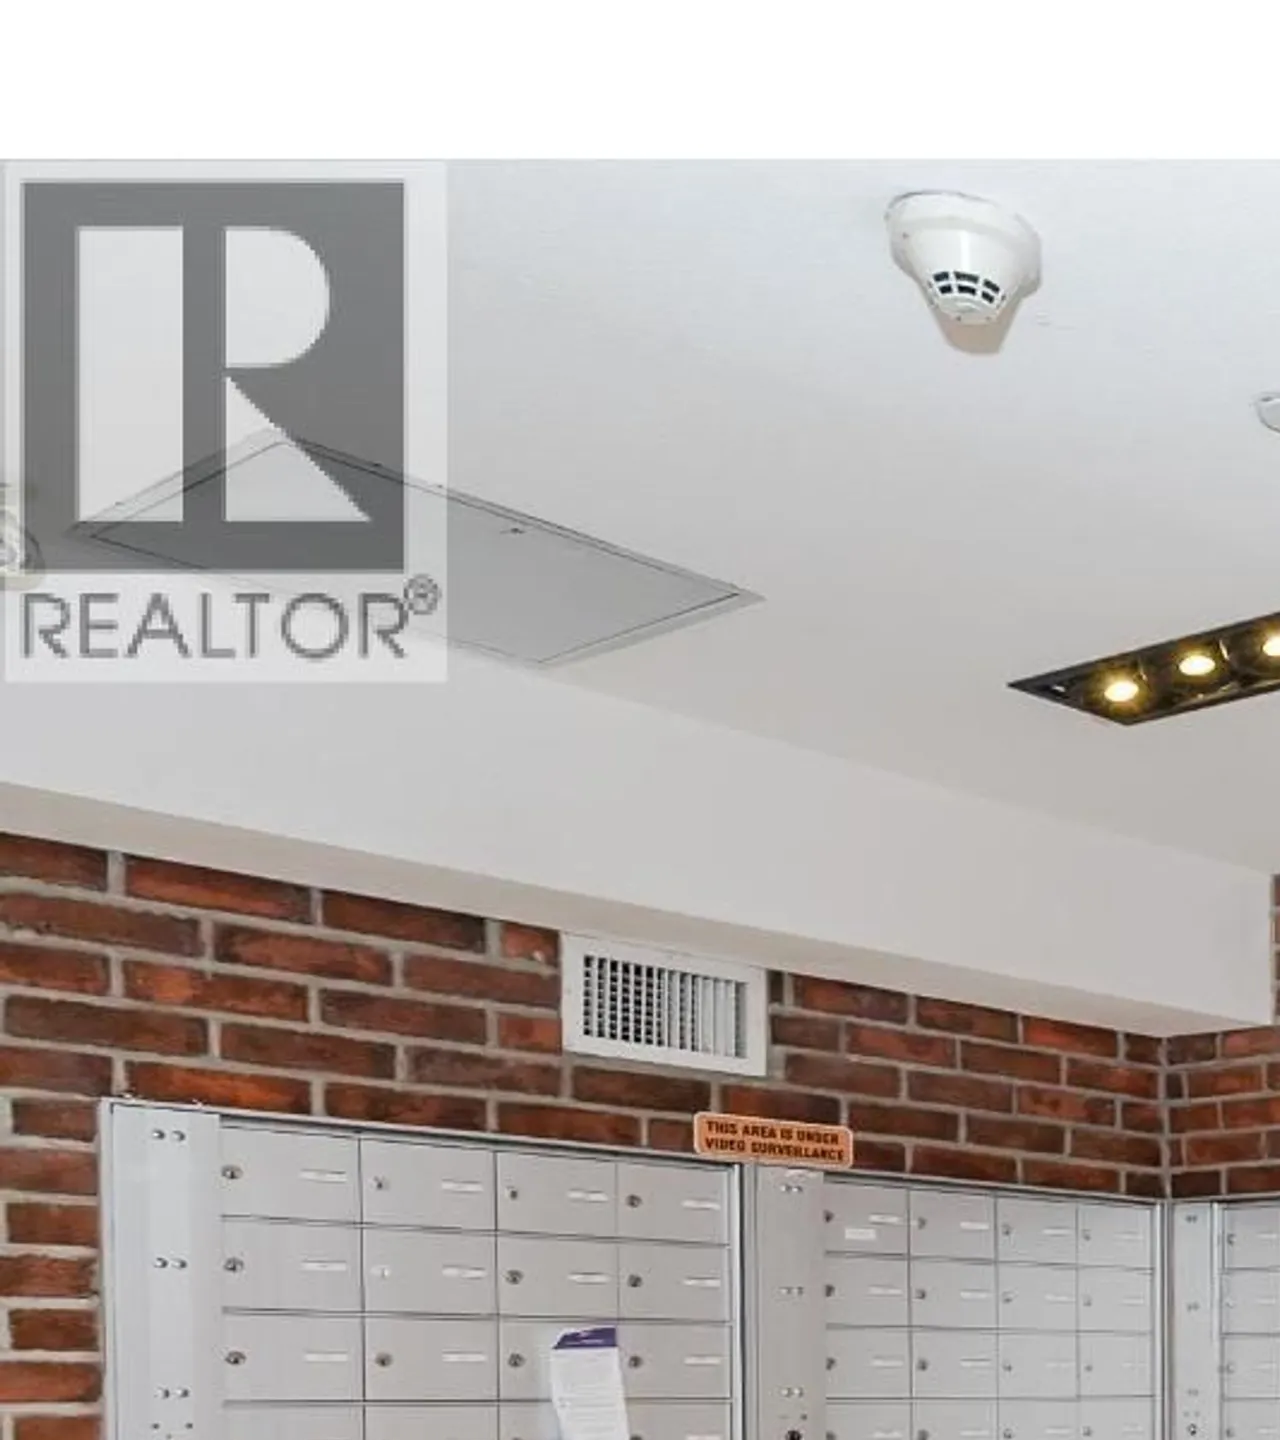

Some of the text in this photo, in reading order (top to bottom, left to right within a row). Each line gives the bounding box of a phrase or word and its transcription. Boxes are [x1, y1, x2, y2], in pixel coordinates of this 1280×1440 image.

[705, 1120, 839, 1145] THIS AREA IS UNDER
[704, 1137, 845, 1161] VIDEO SURVEILLANCE
